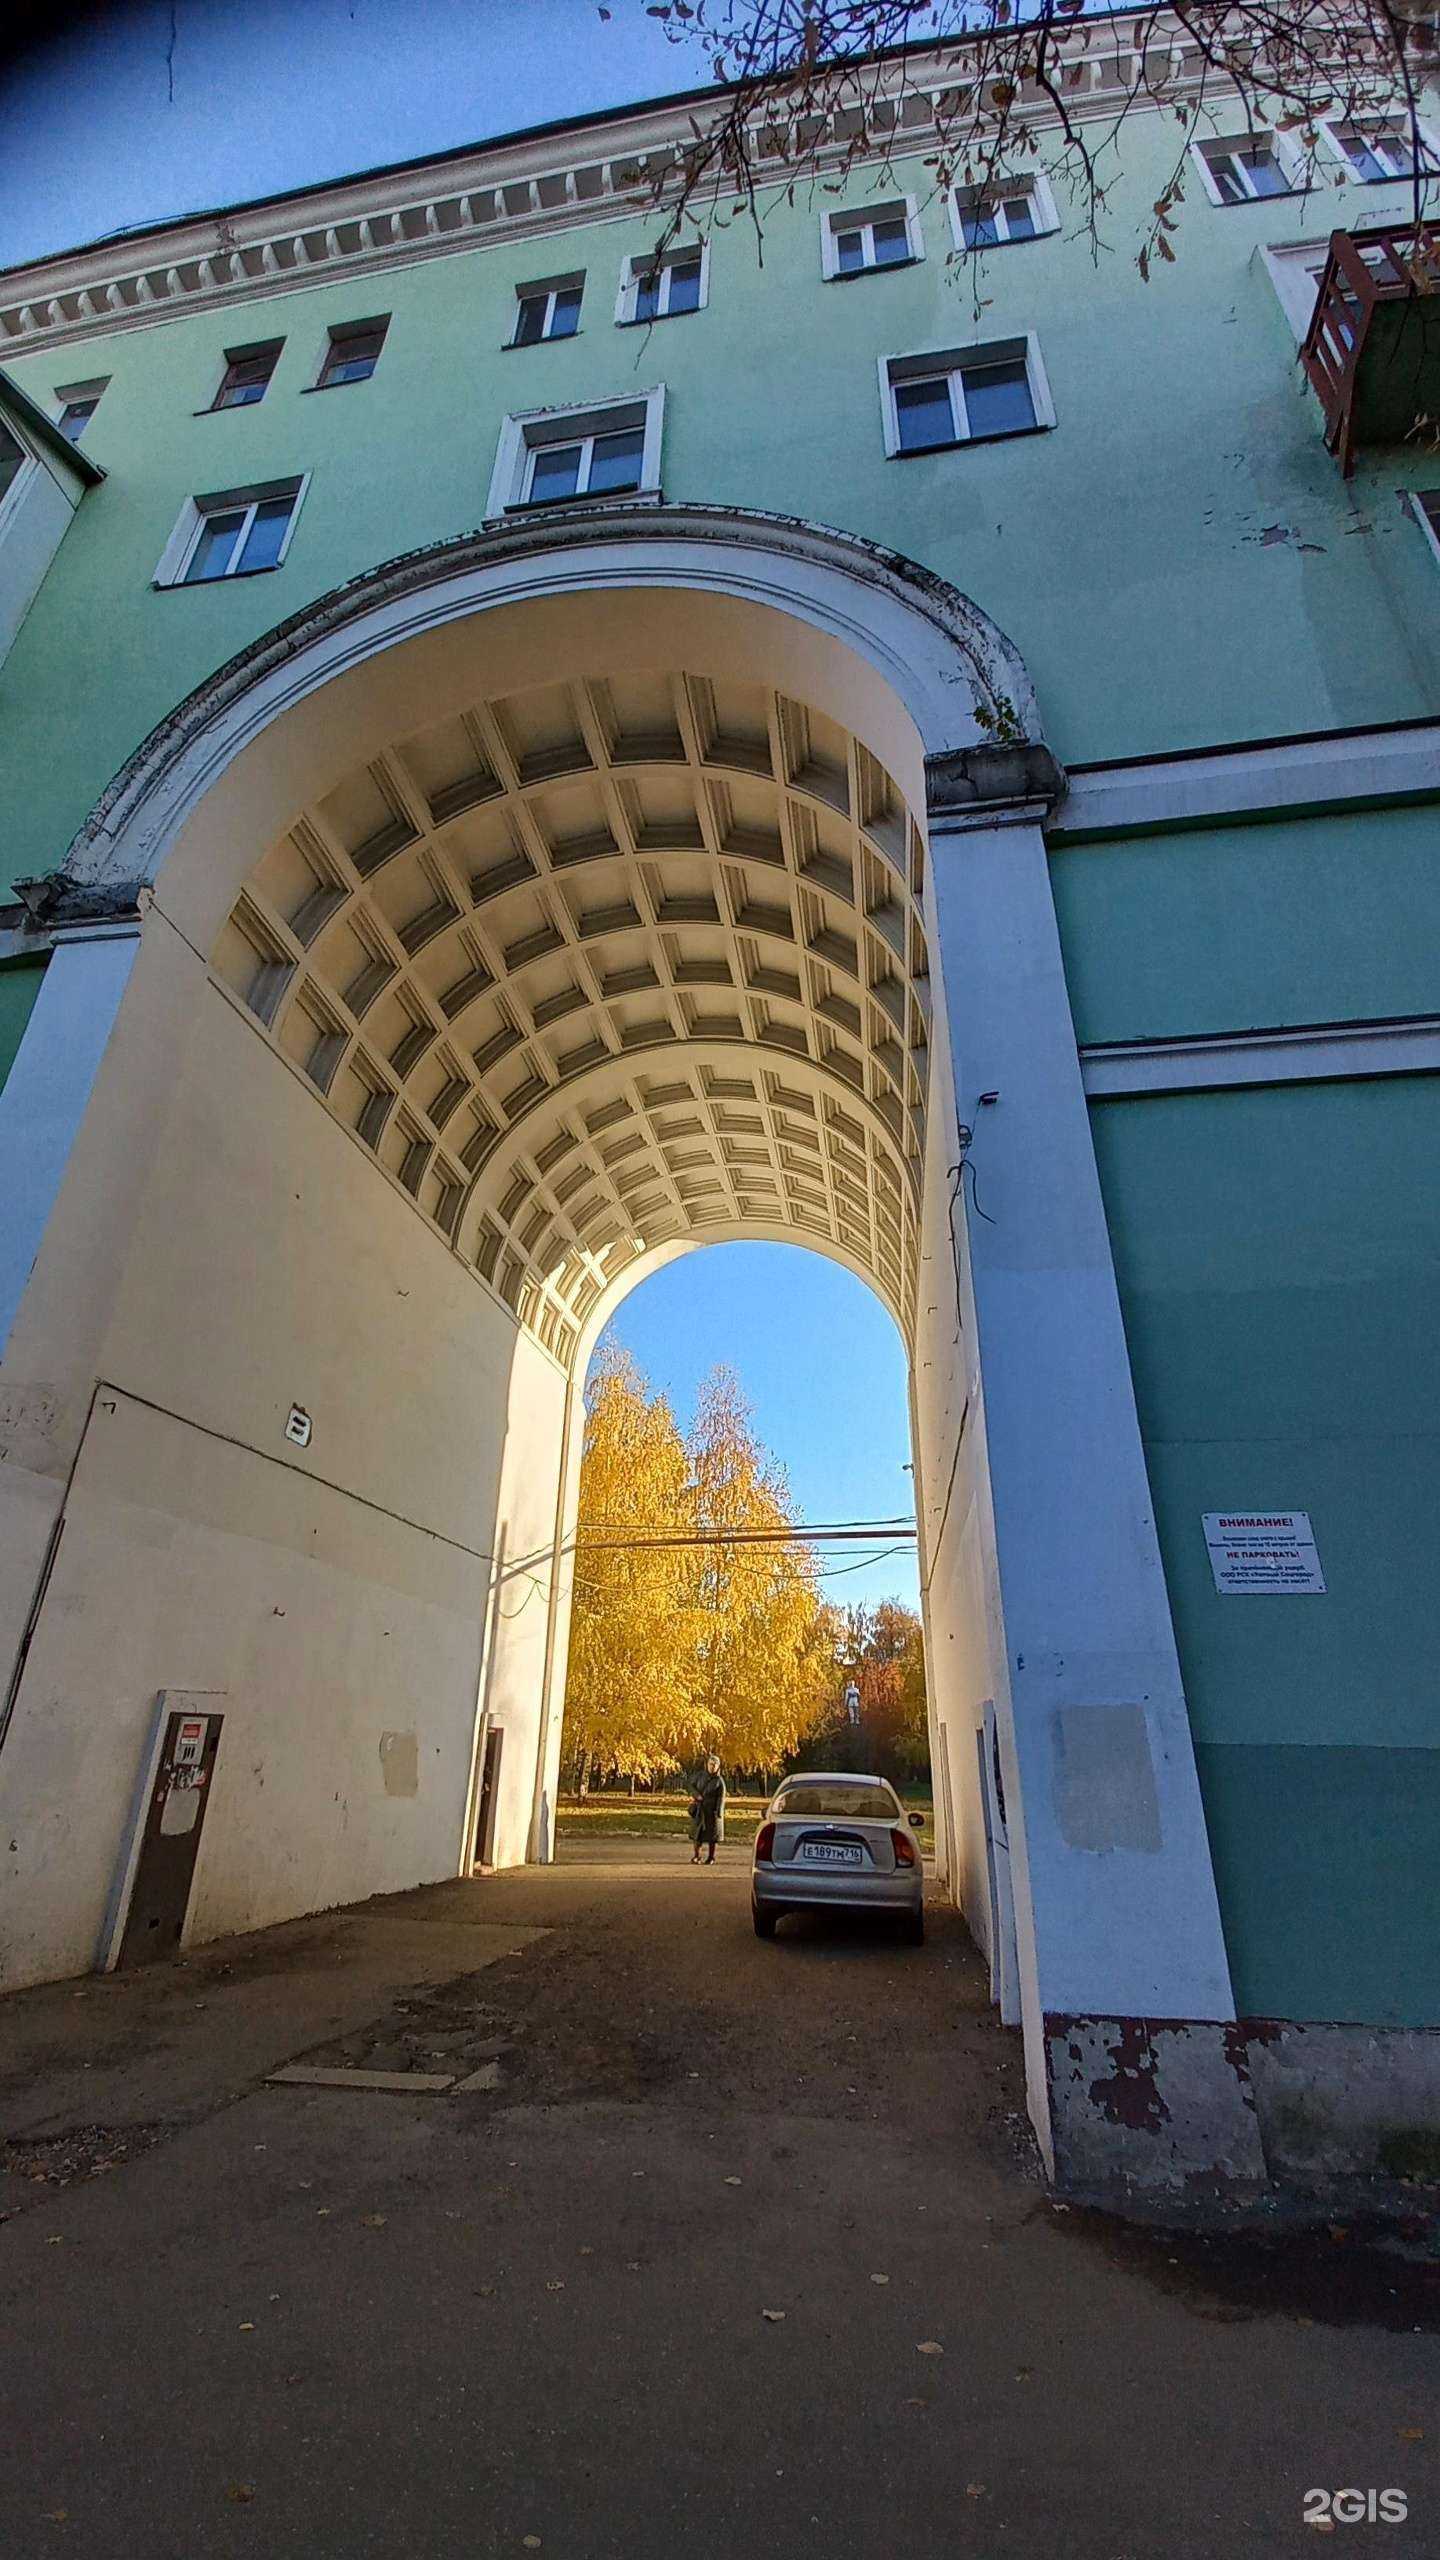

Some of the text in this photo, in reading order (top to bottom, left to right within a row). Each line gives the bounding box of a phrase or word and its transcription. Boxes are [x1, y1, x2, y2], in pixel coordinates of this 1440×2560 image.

[1218, 1517, 1294, 1528] ВНИМАНИЕ!
[1226, 1550, 1300, 1559] НЕ ПАРКОВАТЬ!
